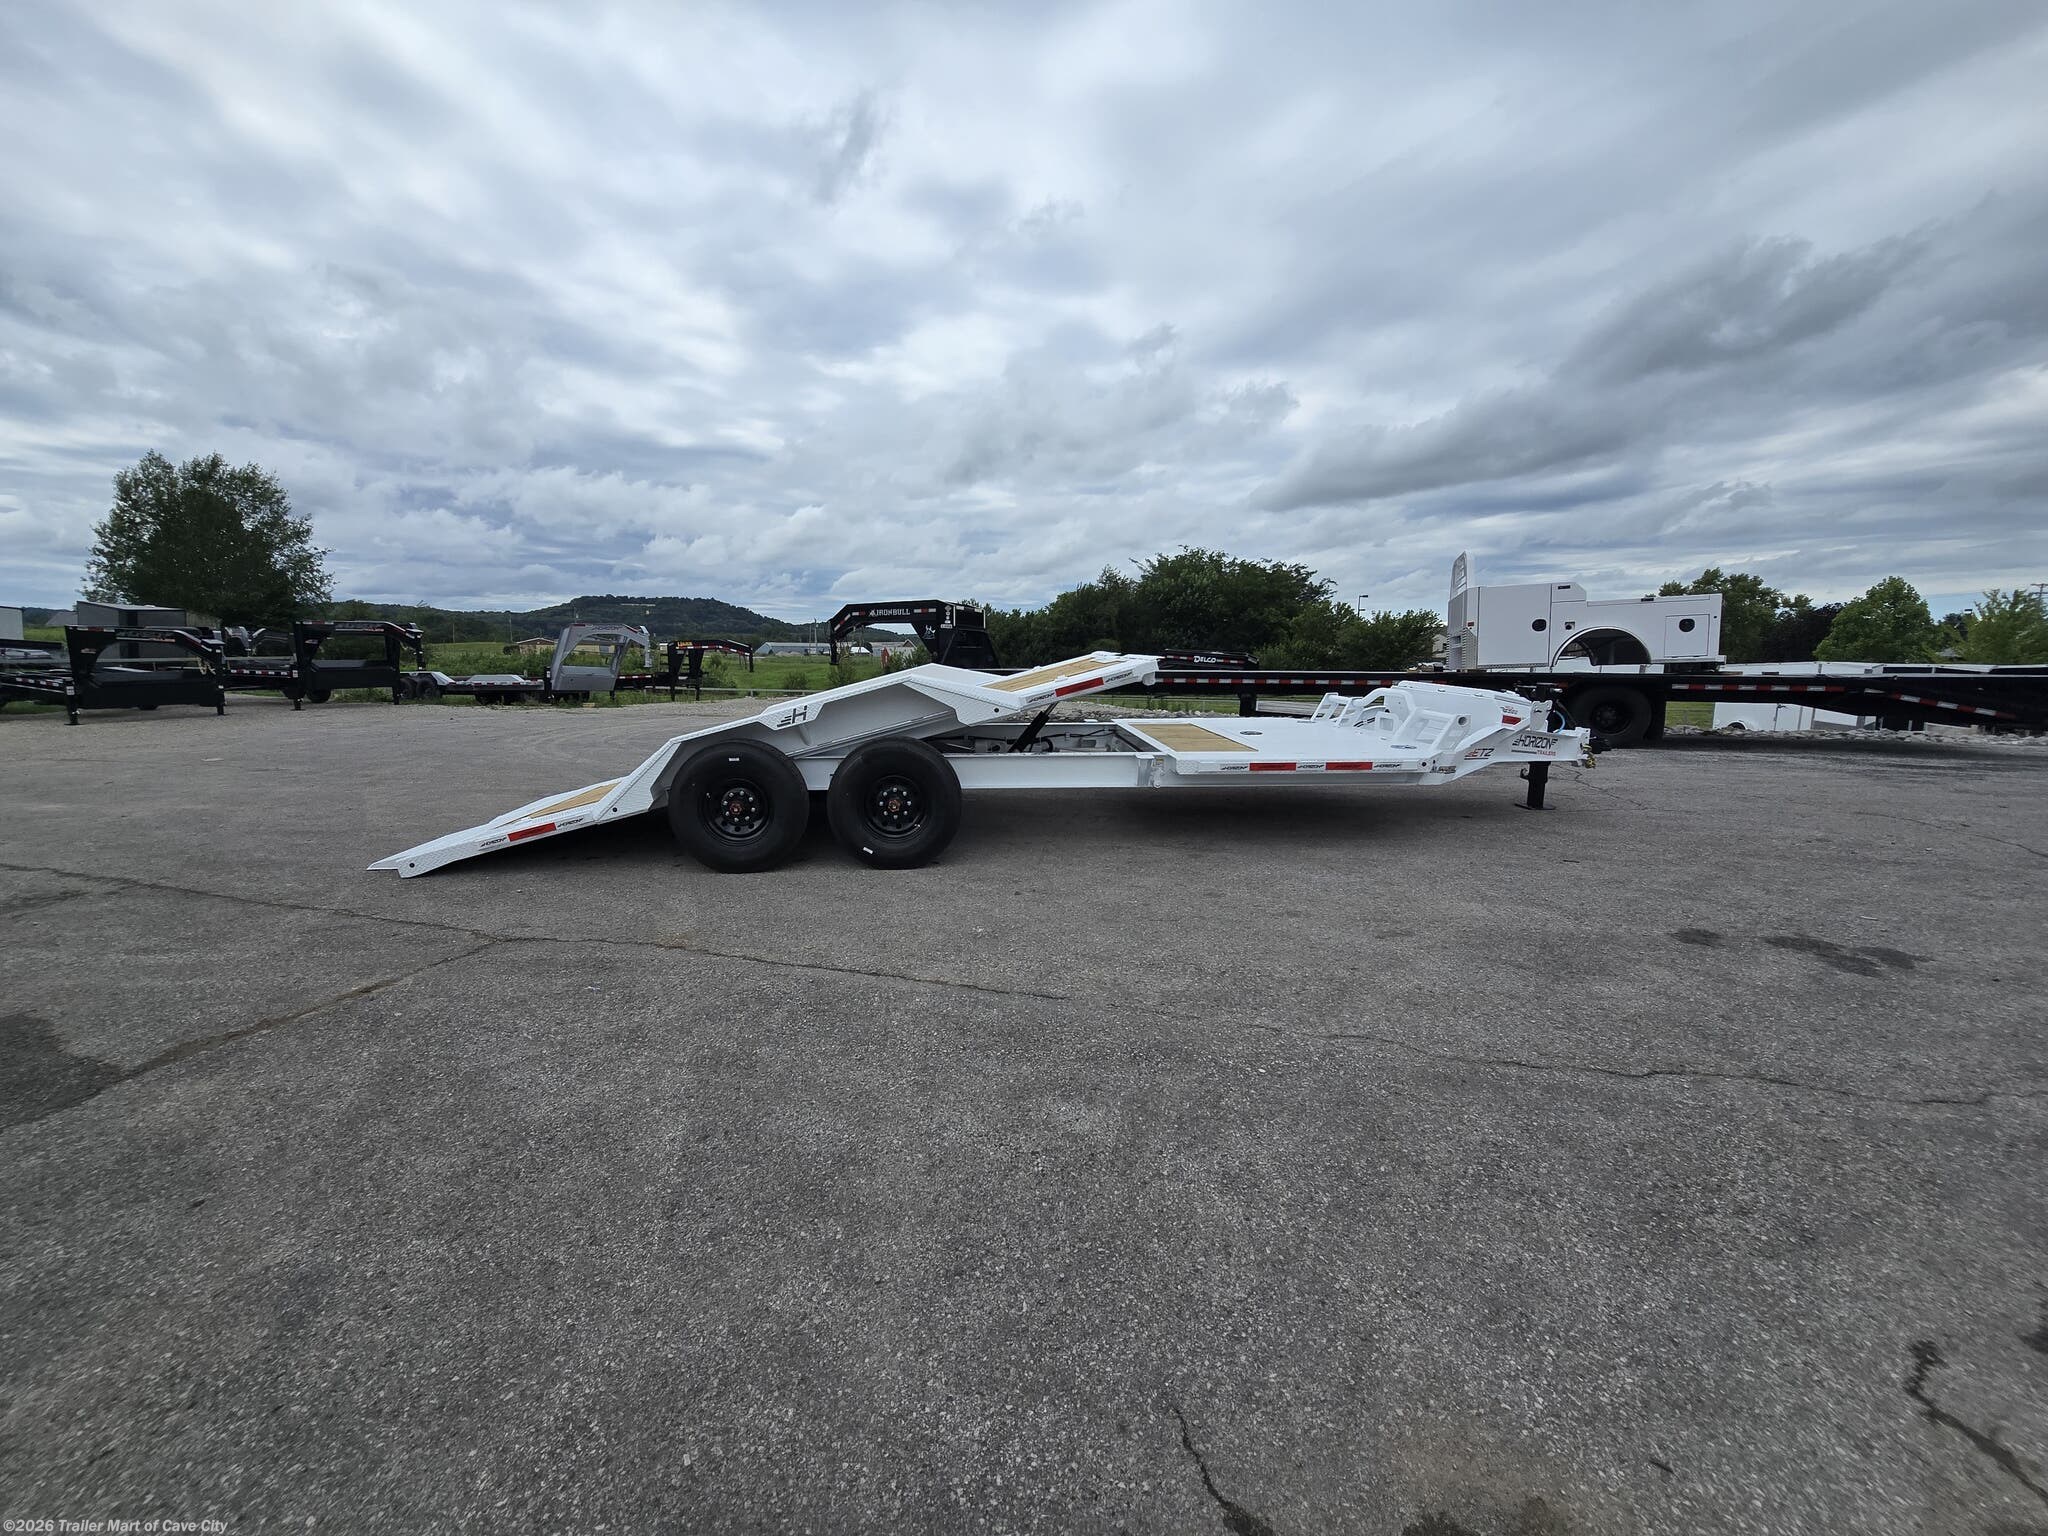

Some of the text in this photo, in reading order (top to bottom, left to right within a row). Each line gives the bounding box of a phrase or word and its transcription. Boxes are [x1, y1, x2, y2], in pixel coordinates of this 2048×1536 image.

[876, 608, 911, 616] IRONBULL
[1193, 655, 1217, 663] DELCO
[1514, 734, 1557, 750] HORIZON
